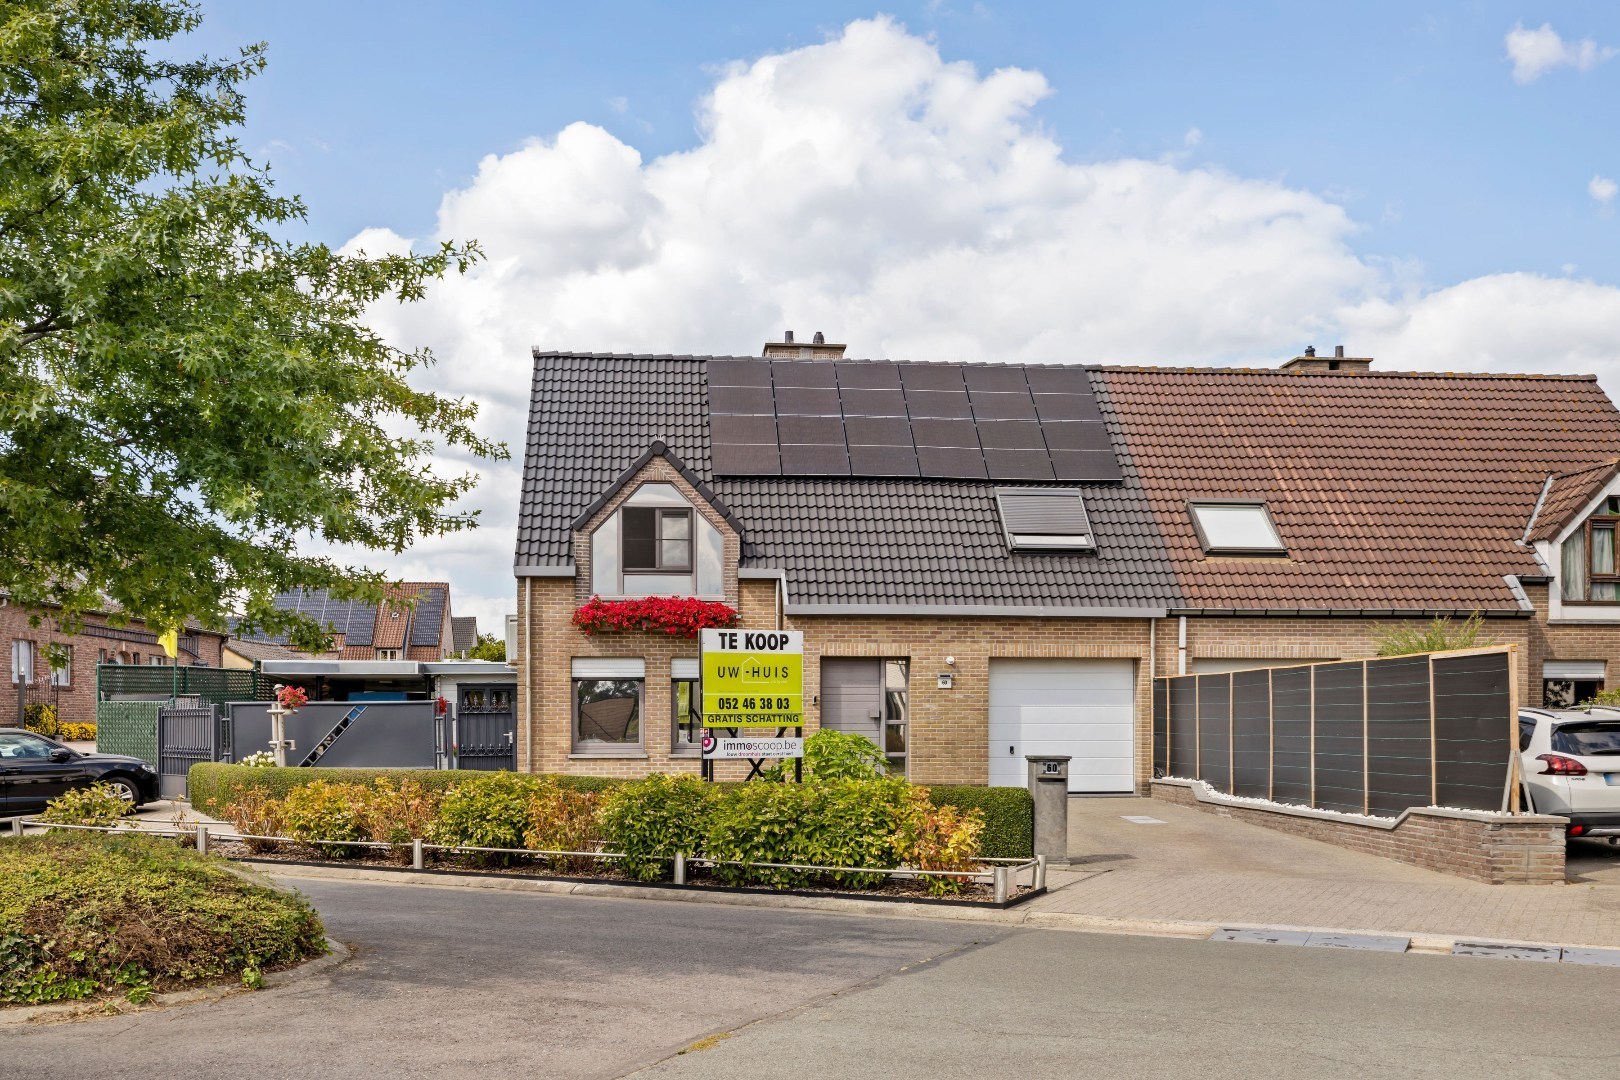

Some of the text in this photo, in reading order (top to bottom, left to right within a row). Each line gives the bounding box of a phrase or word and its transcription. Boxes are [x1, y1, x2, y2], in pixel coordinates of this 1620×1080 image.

[718, 632, 790, 651] TE KOOP
[718, 697, 790, 710] 052 46 38 03
[707, 714, 799, 723] GRATIS SCHATTING
[723, 740, 797, 751] immoscoop.be
[1046, 763, 1058, 773] 60
